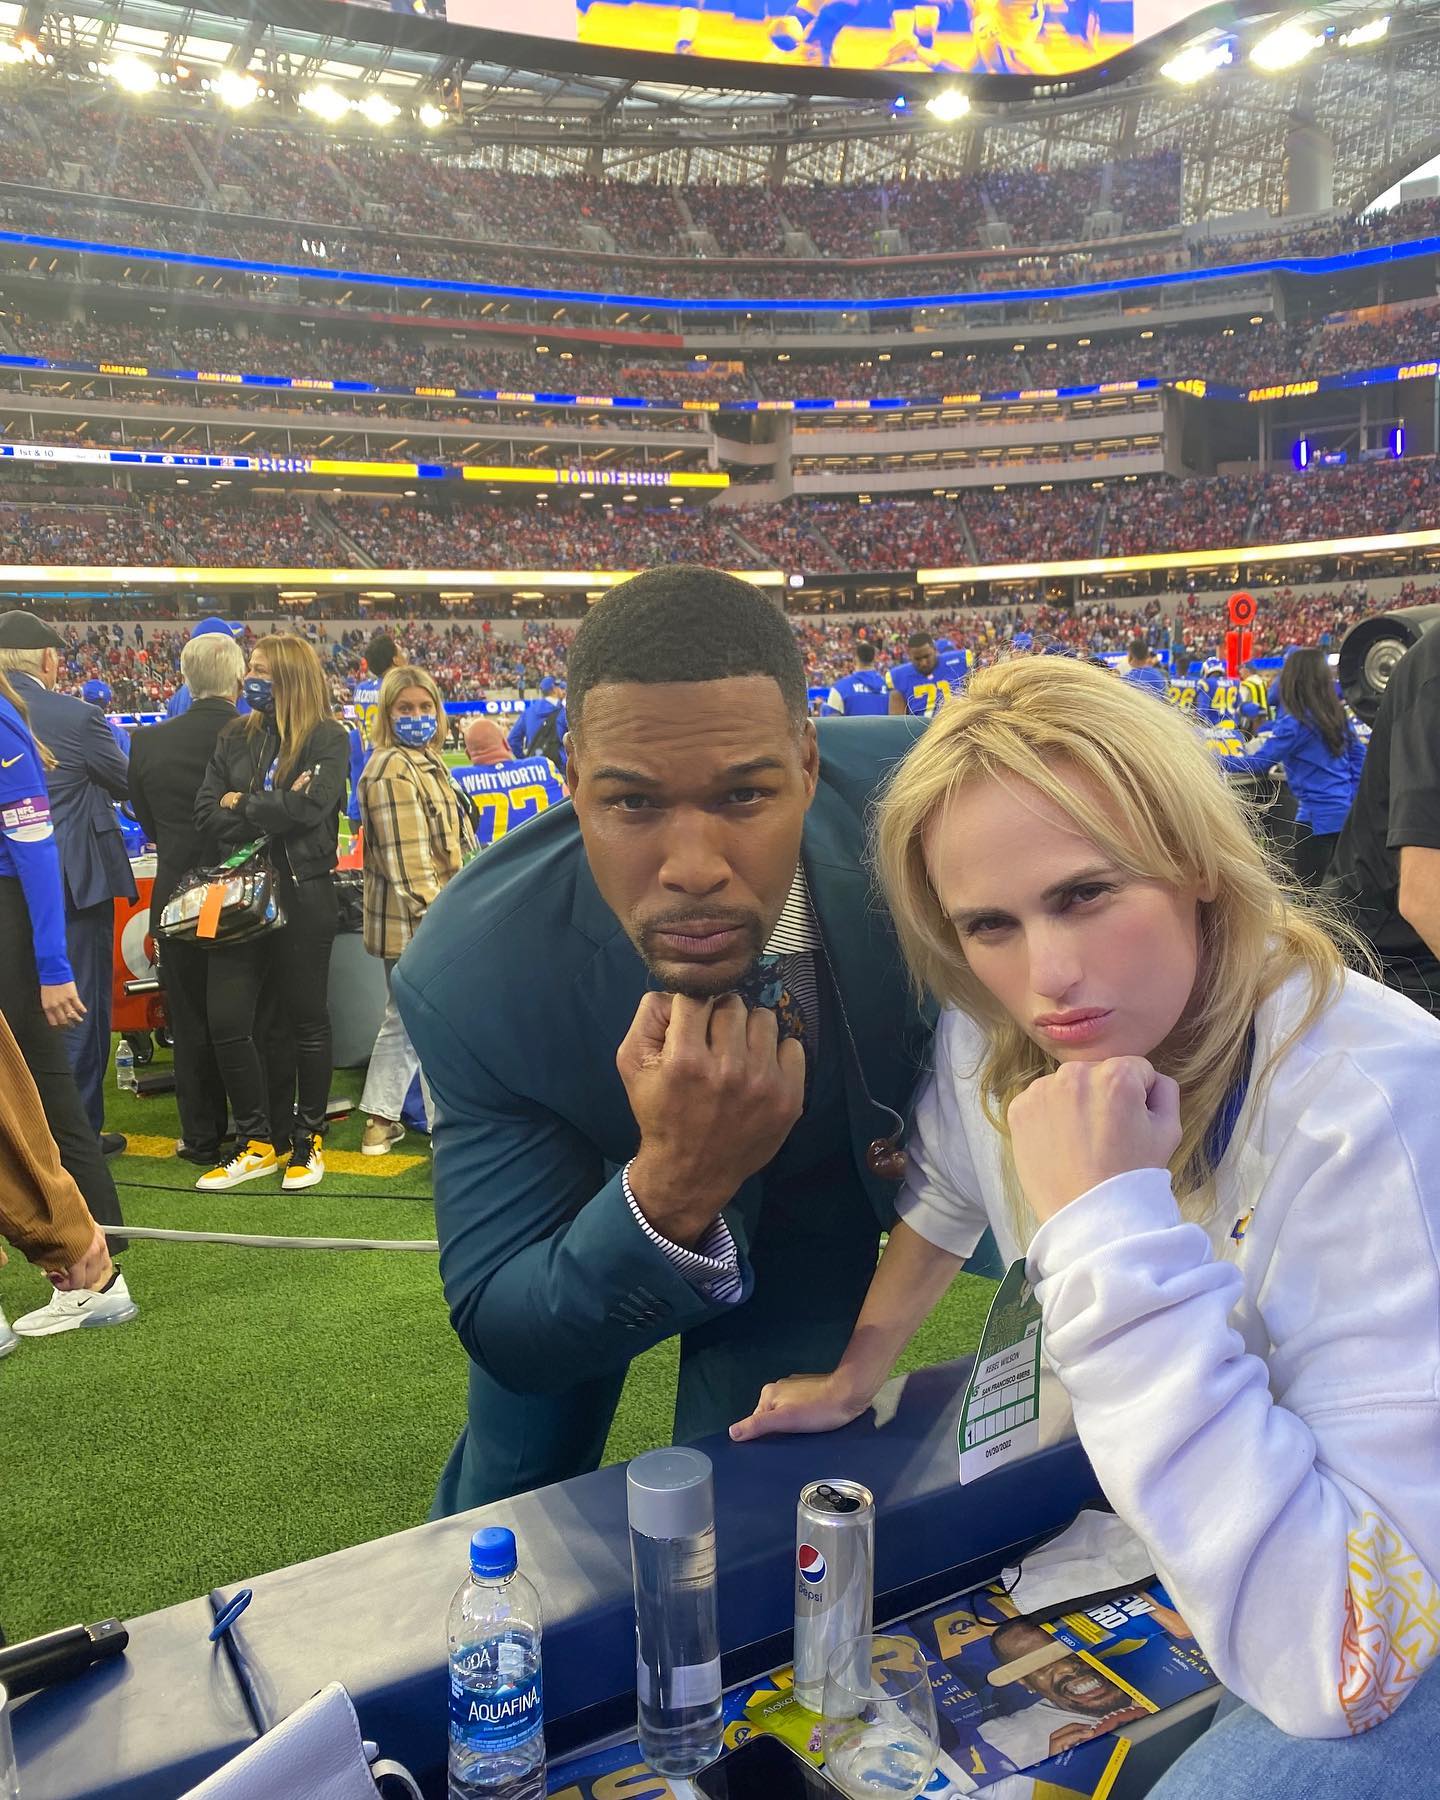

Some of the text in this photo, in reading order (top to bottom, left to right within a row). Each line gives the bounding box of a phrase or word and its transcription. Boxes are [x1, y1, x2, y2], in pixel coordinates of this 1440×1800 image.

[99, 364, 148, 376] RAMS FANS
[1398, 363, 1438, 380] RAMS
[1248, 380, 1319, 402] RAMS FANS
[486, 701, 526, 712] OUR
[463, 765, 547, 793] WHITWORTH
[472, 784, 549, 842] 77
[1000, 1351, 1020, 1367] WILSON
[991, 1374, 1016, 1391] FRANCISCO
[967, 1430, 973, 1445] 1
[468, 1685, 536, 1723] AQUAFINA
[942, 1690, 978, 1707] STAR.
